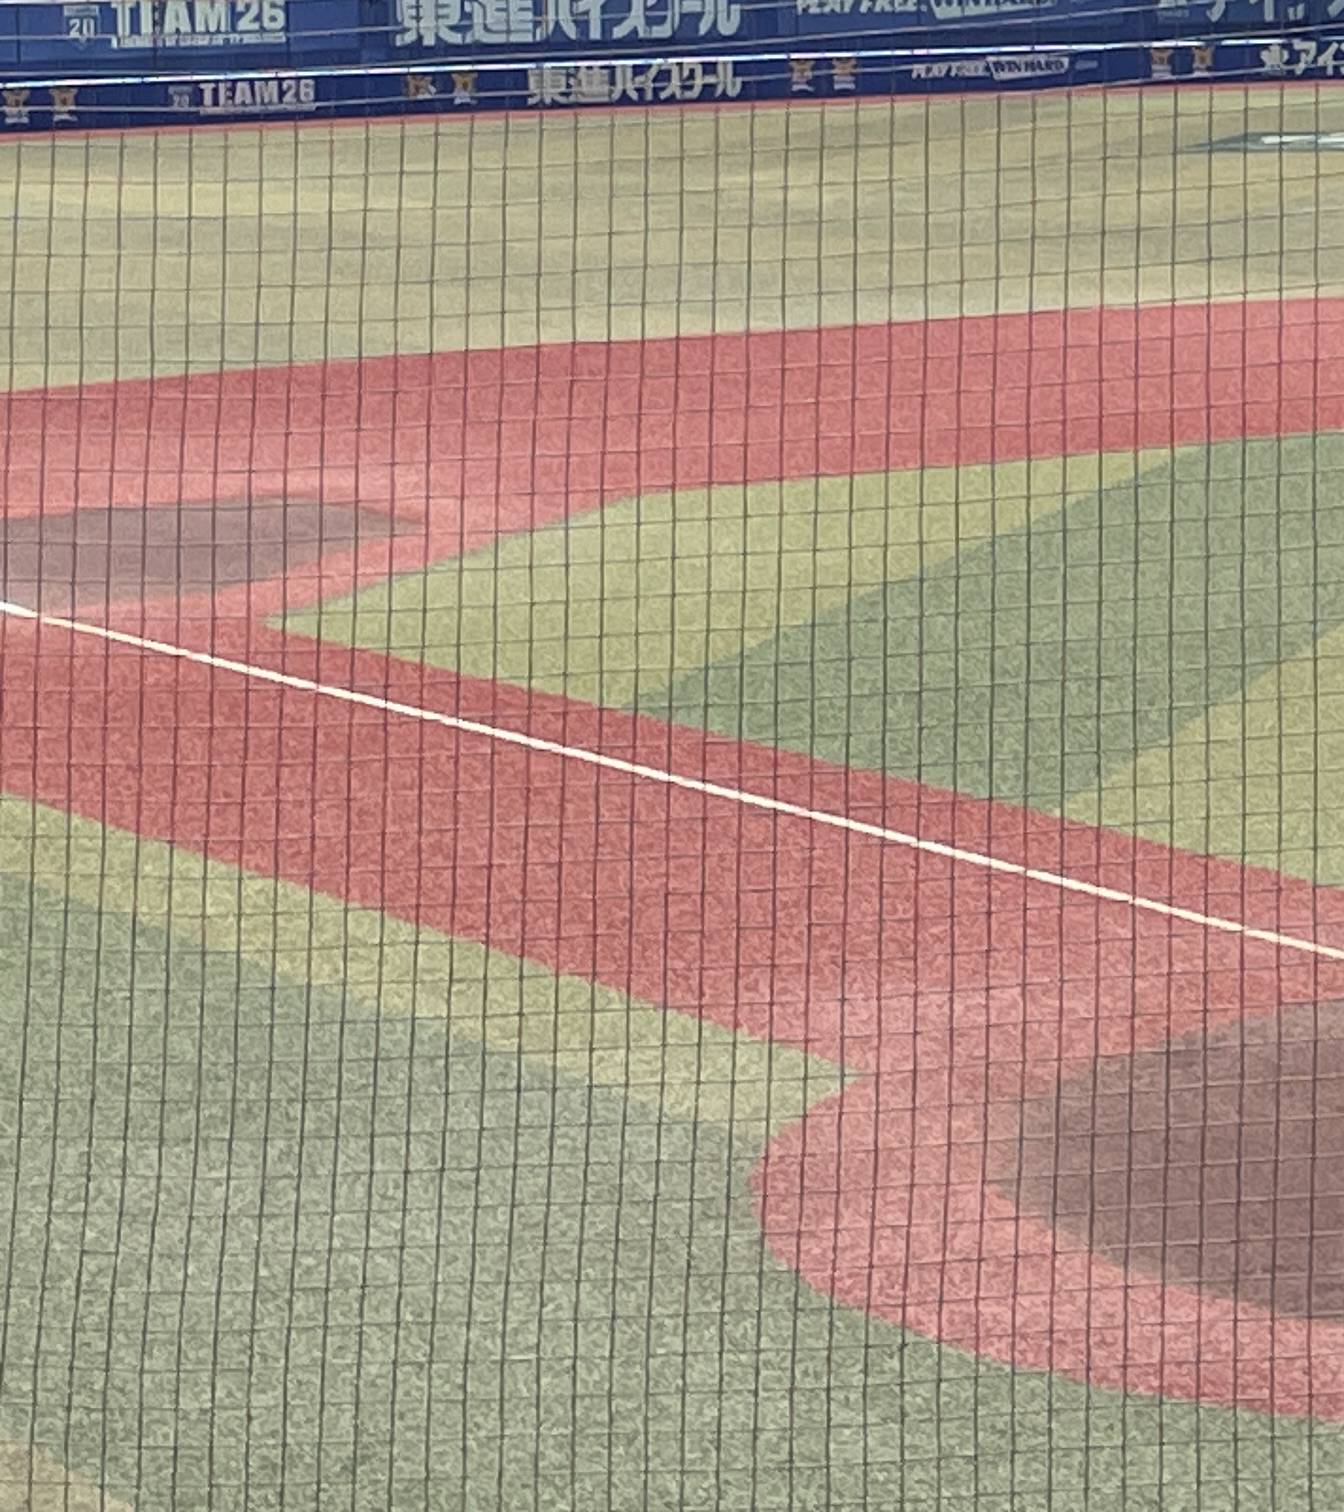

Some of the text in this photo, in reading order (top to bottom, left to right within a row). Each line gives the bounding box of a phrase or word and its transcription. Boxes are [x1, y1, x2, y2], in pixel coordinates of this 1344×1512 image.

[527, 58, 742, 105] 東進ハイスクール
